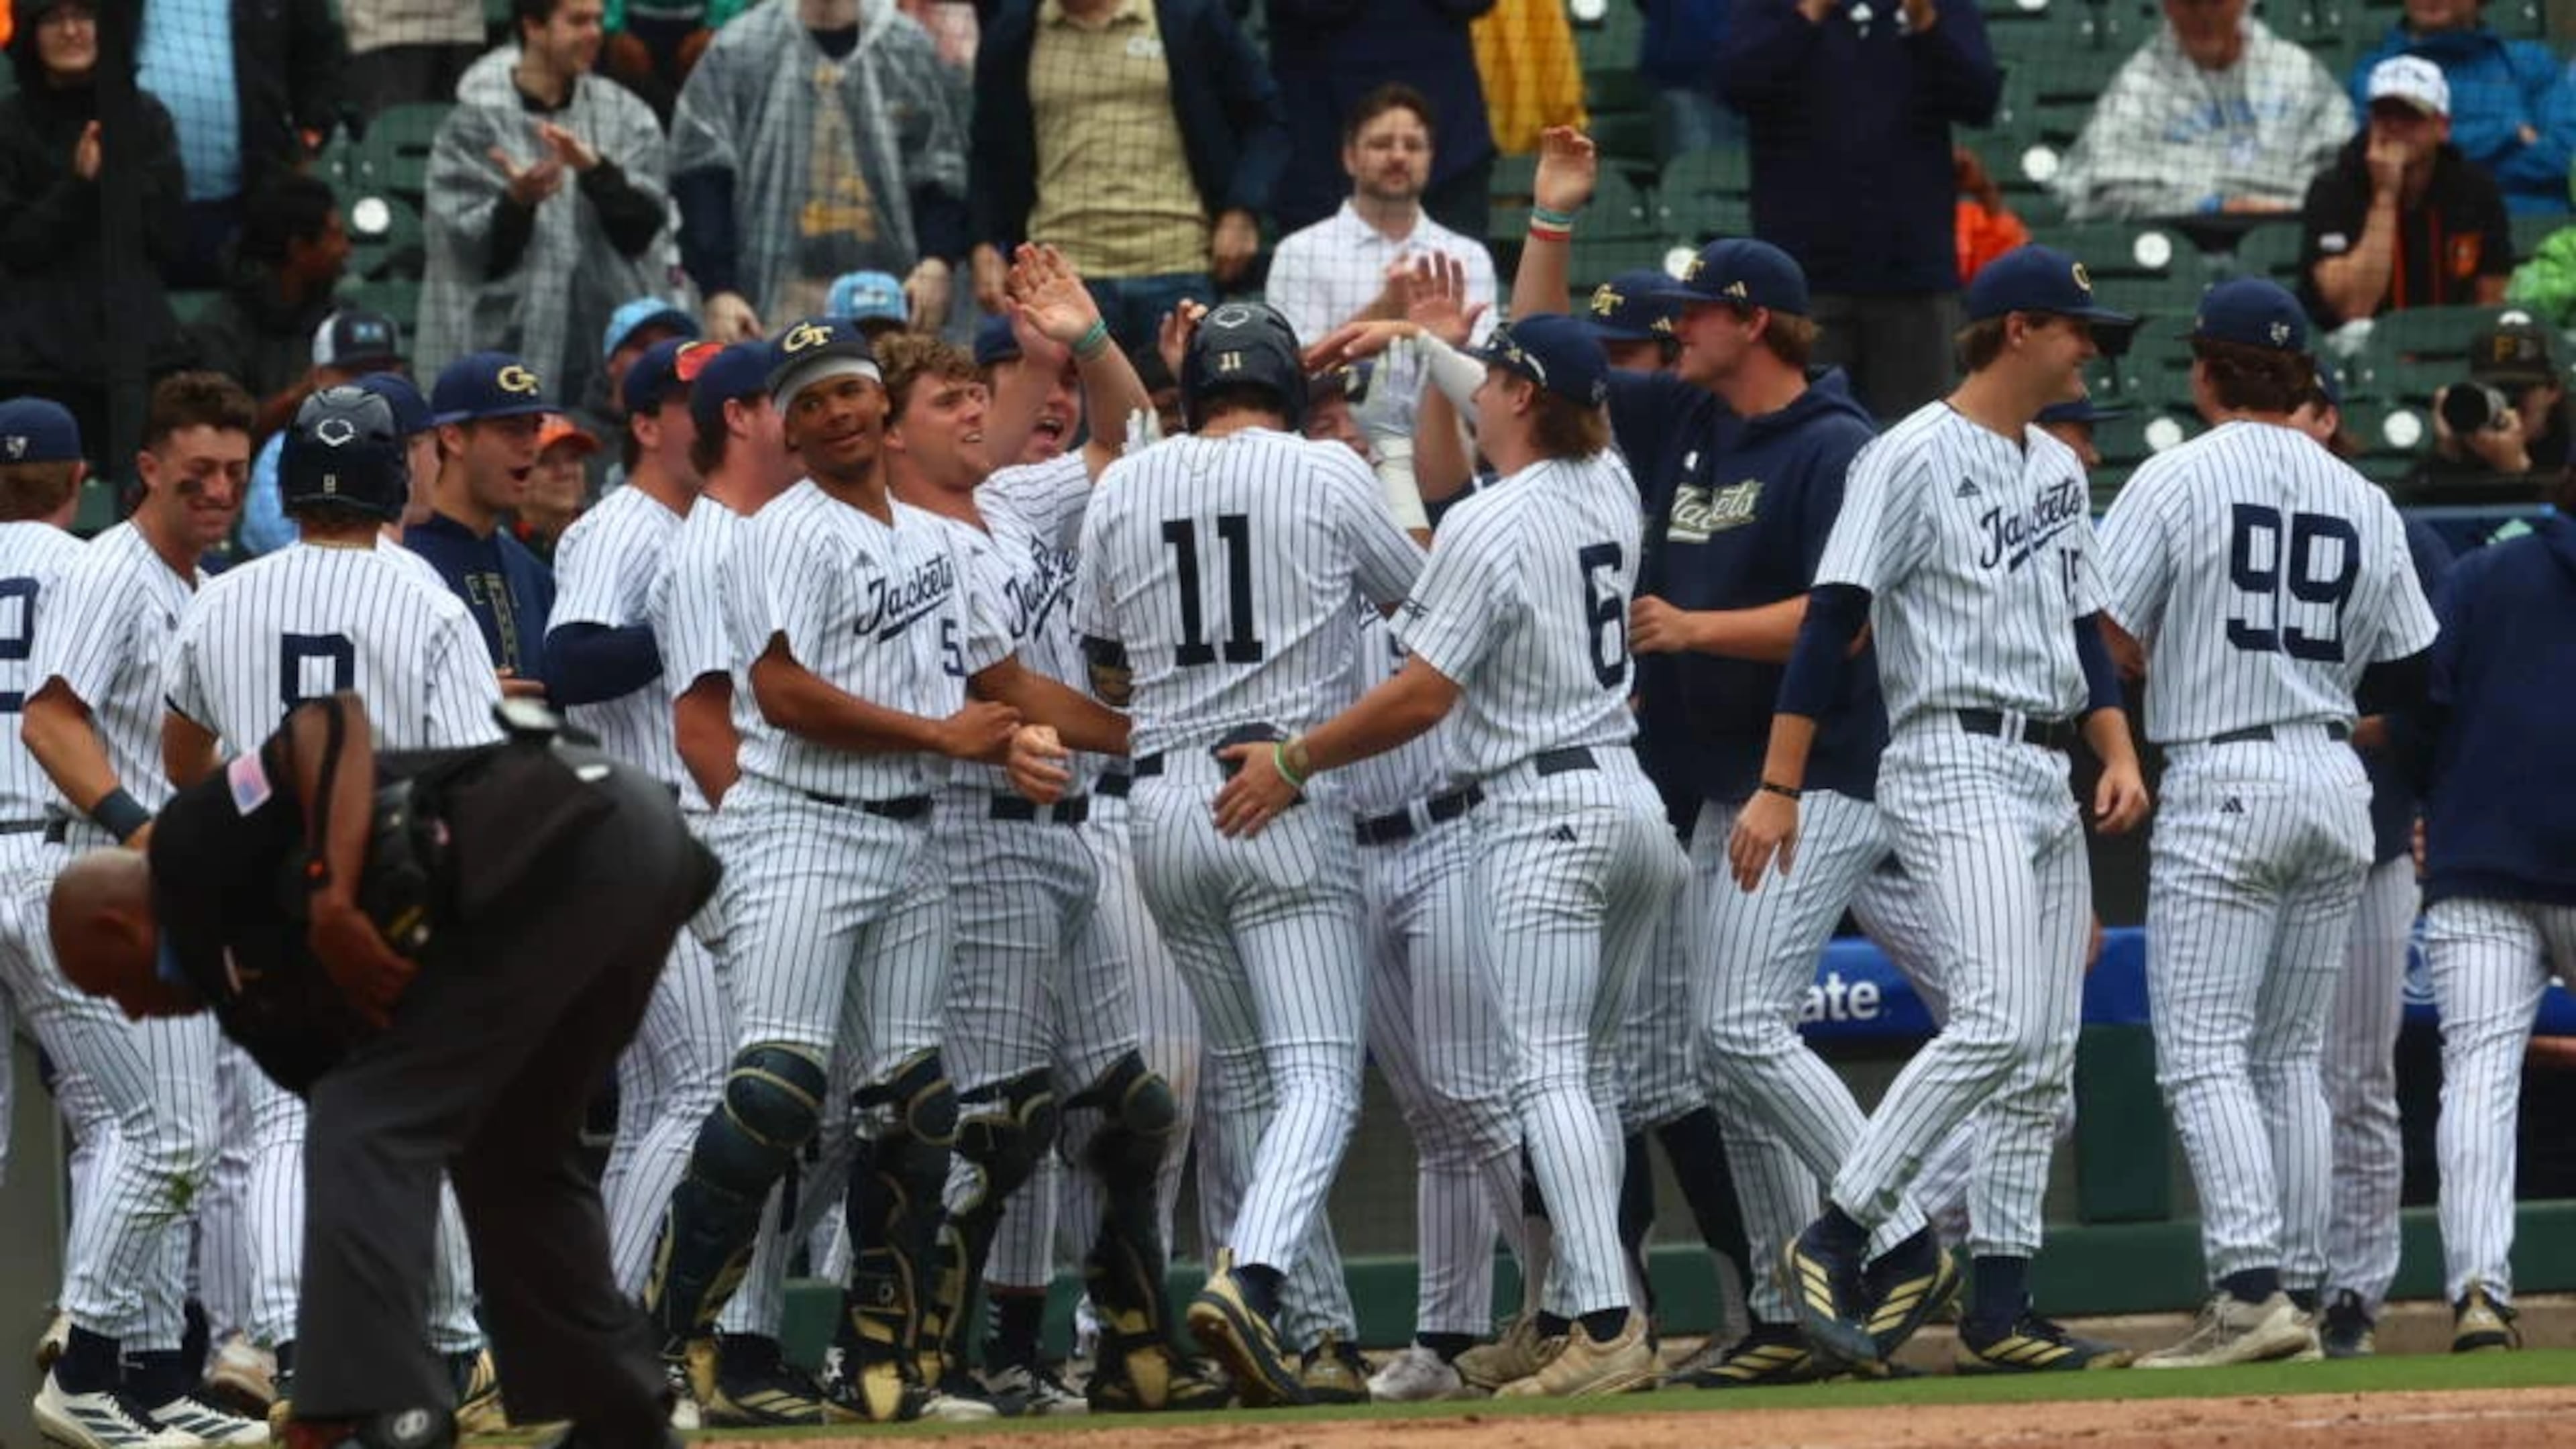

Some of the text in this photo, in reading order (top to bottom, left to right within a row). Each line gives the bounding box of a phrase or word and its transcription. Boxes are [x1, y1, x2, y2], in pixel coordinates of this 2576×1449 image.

[784, 321, 834, 352] GT
[1220, 351, 1242, 372] 11
[1161, 514, 1263, 666] 11
[1578, 541, 1626, 690] 6
[2226, 503, 2360, 663] 99
[941, 619, 967, 676] 5
